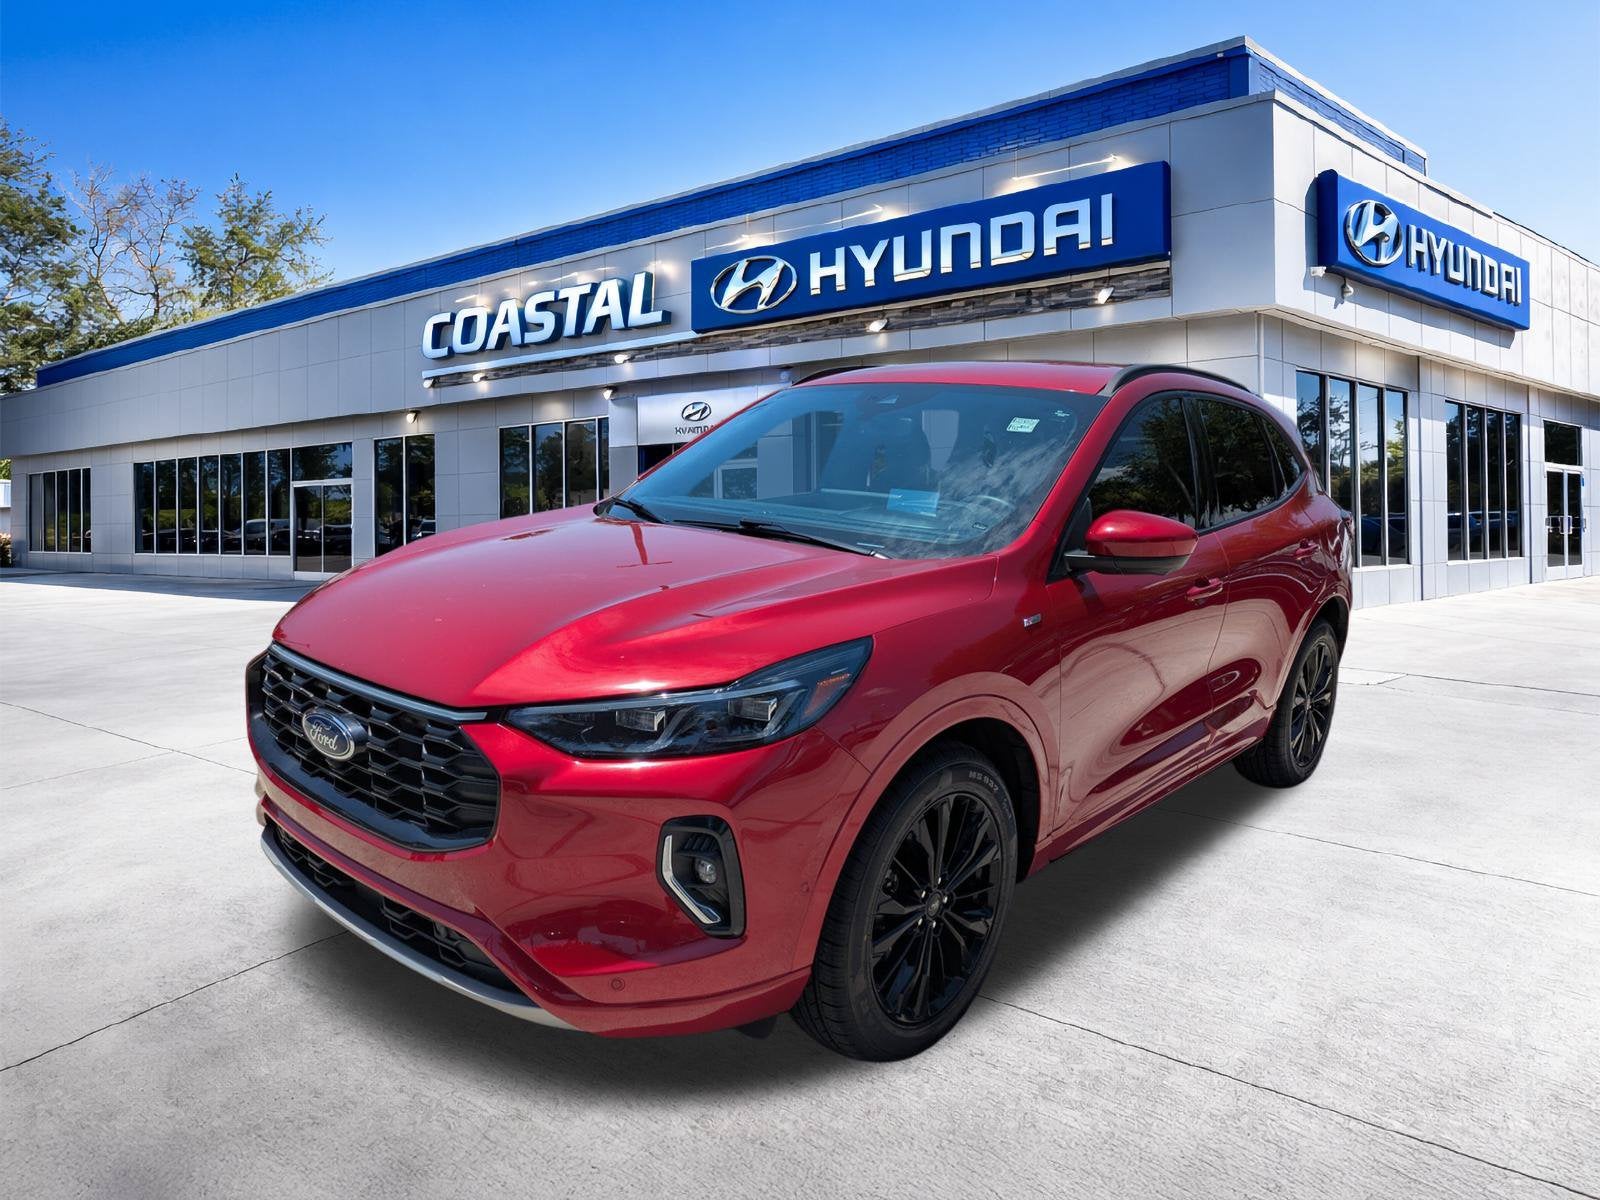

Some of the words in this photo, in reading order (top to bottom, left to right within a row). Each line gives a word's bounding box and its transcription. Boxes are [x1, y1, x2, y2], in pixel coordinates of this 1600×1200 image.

[809, 193, 1113, 295] HYUNDAI
[1406, 223, 1522, 306] HYUNDAI
[422, 271, 671, 360] COASTAL
[310, 720, 338, 750] Ford
